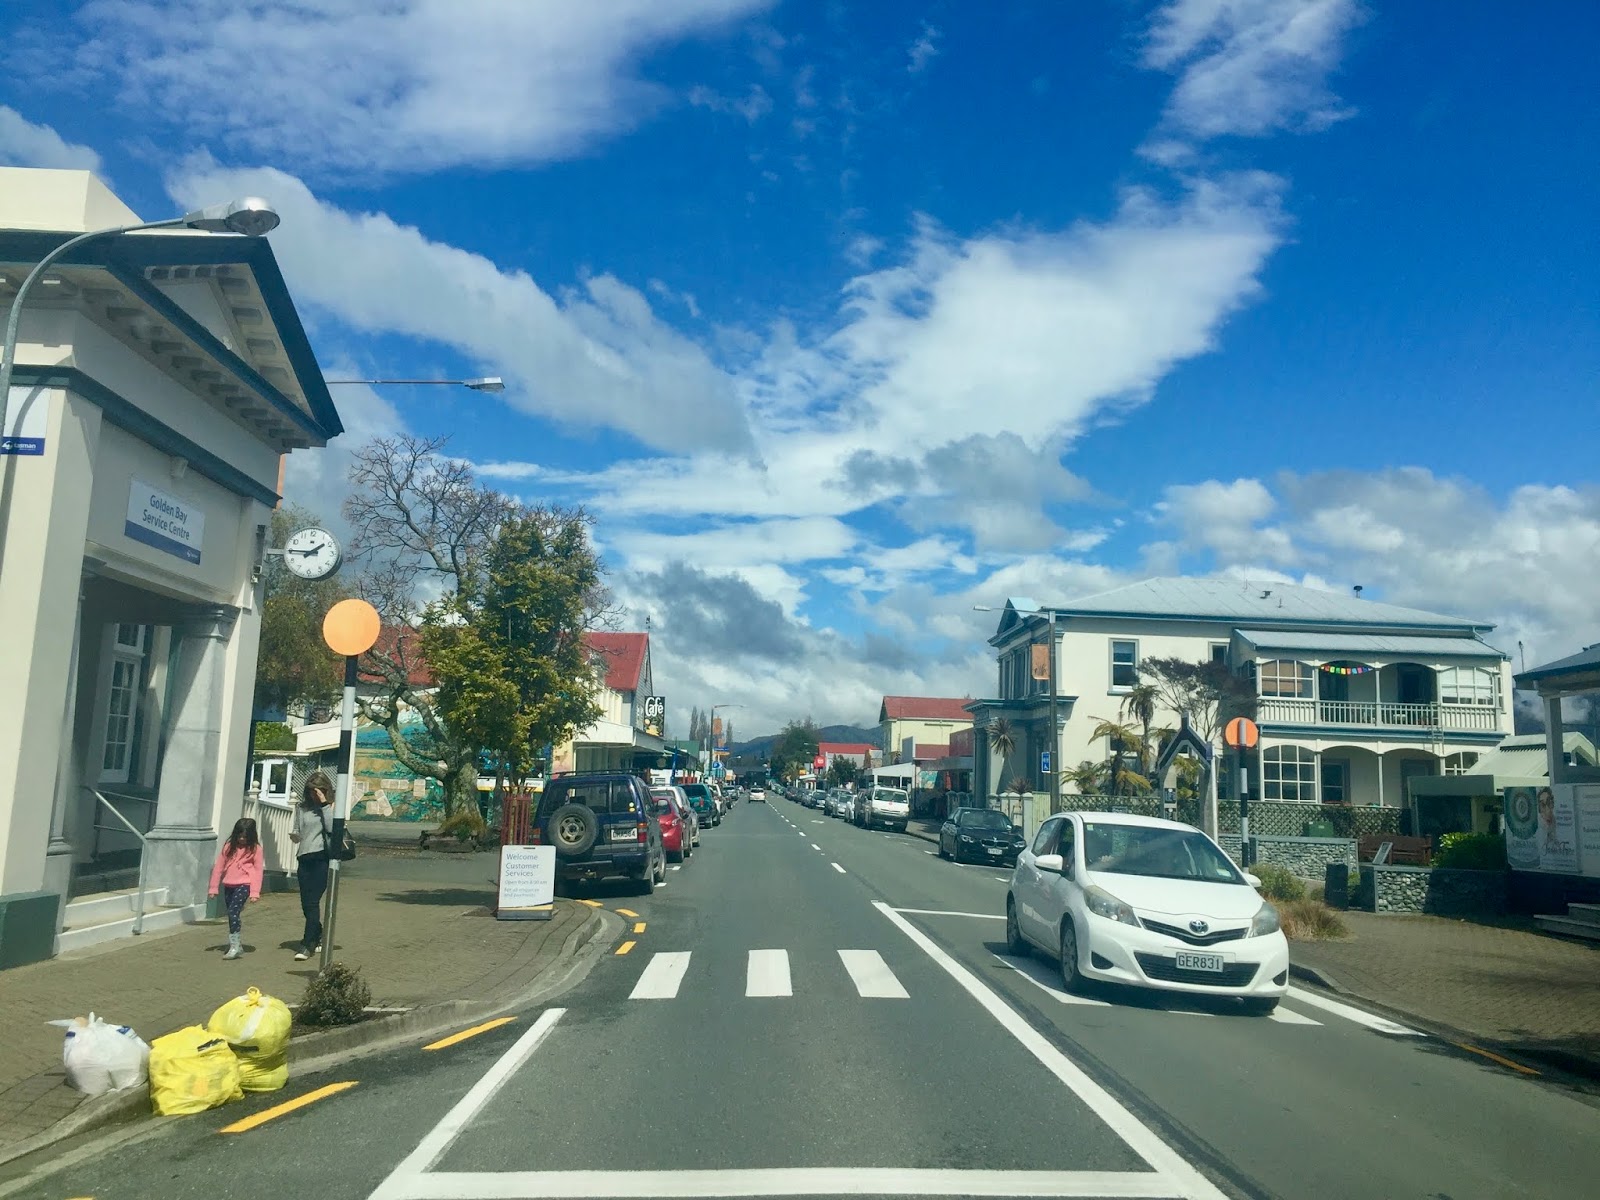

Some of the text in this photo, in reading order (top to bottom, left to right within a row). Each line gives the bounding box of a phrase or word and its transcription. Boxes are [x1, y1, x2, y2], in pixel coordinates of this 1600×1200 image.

[150, 494, 188, 524] Golden Bay
[142, 509, 190, 540] Service Centre
[645, 697, 664, 716] Café
[1178, 955, 1220, 969] GER831
